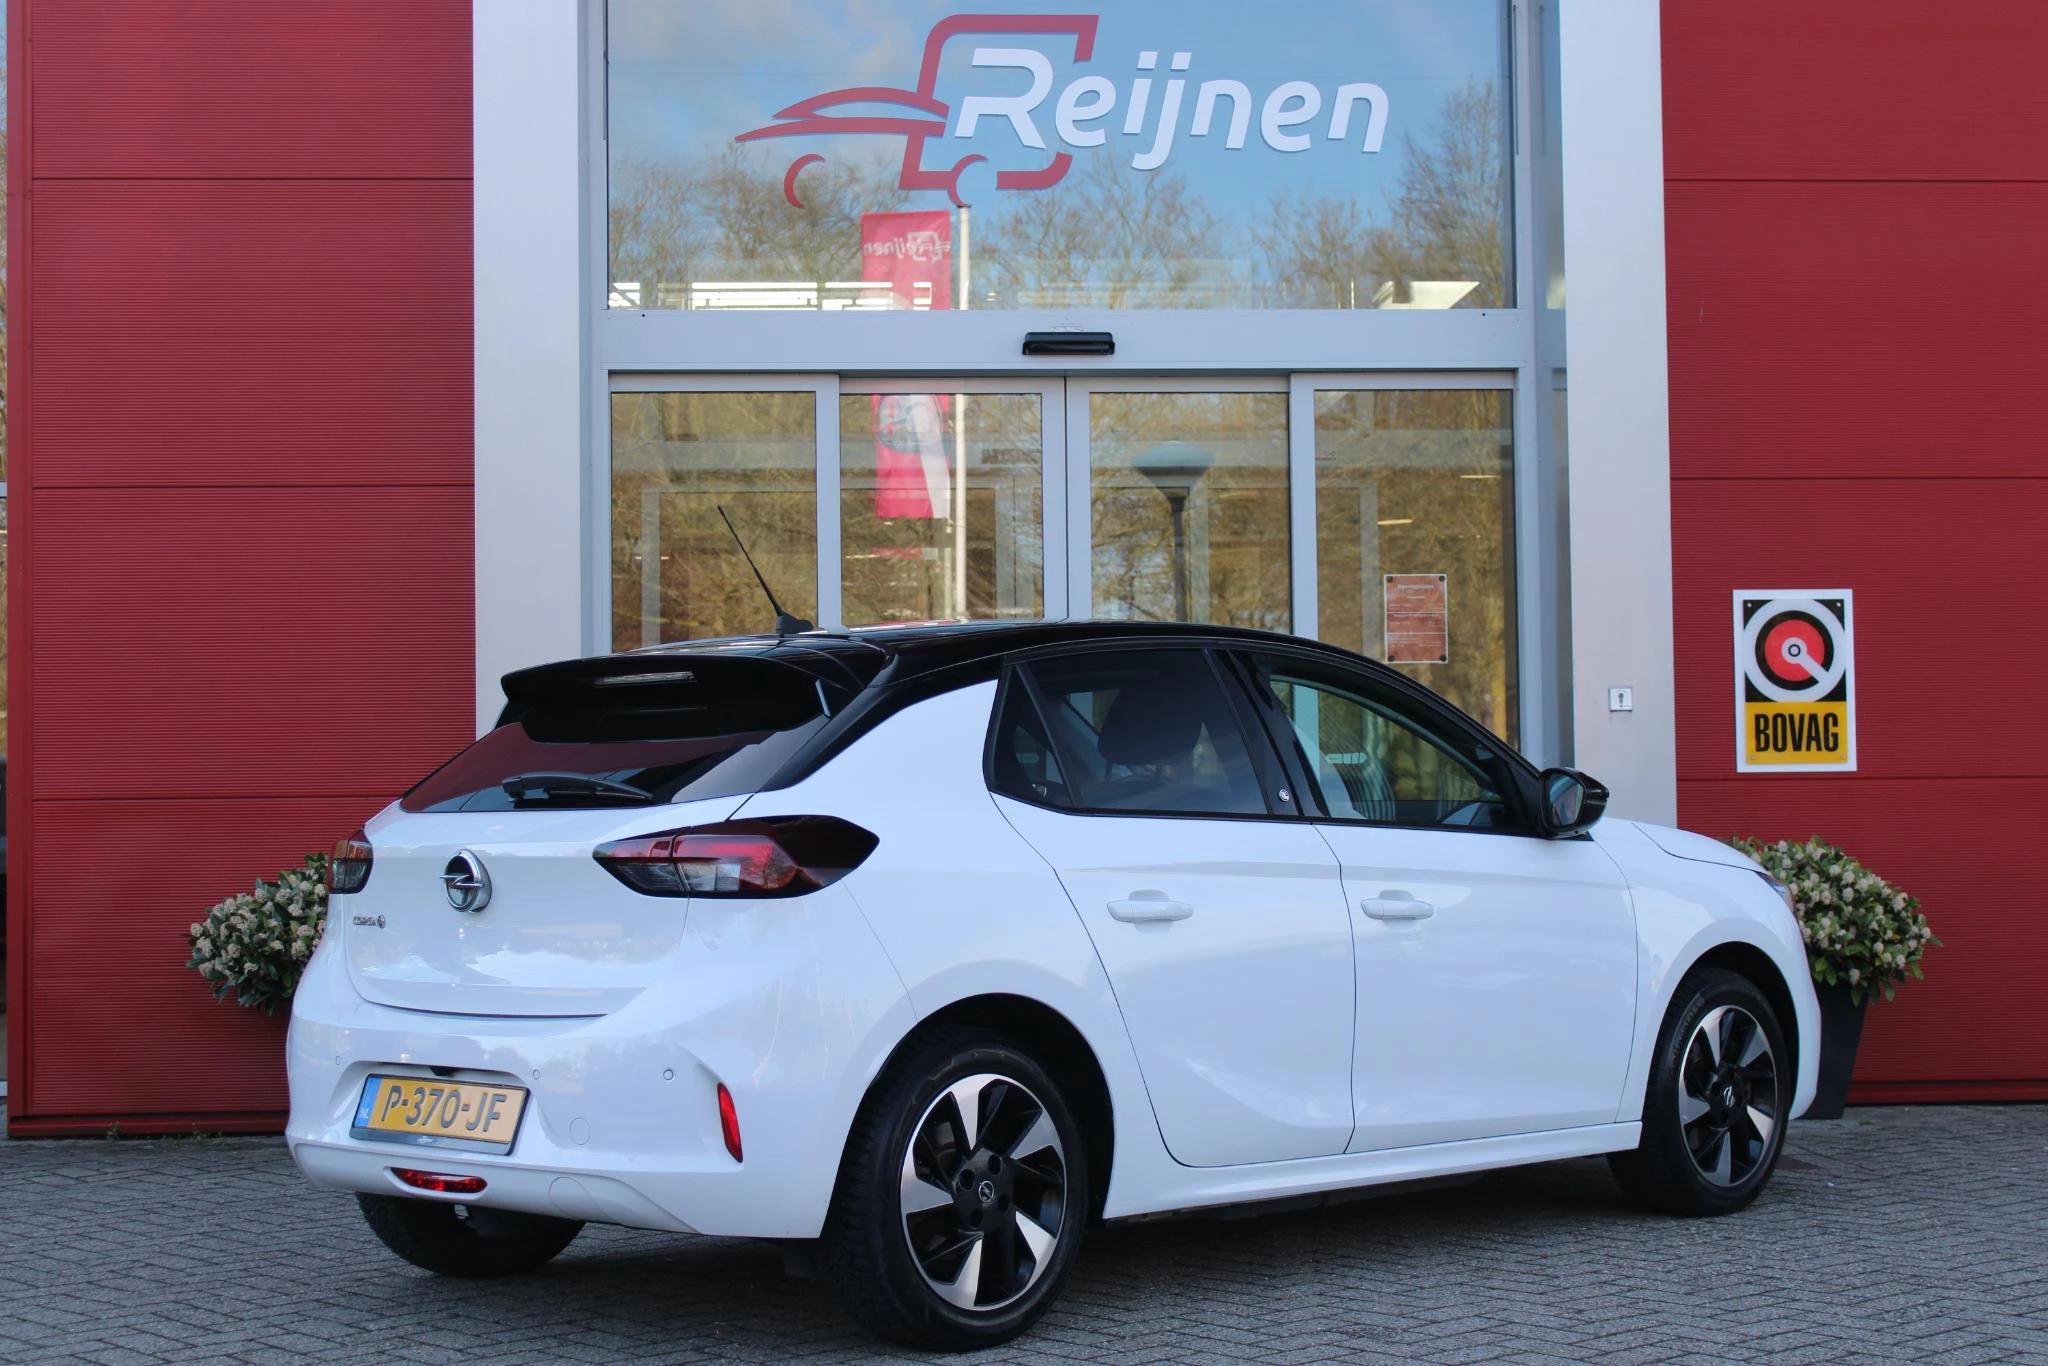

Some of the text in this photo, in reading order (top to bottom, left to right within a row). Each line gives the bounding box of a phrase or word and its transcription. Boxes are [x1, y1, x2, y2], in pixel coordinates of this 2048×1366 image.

[954, 47, 1389, 170] Reijnen
[1754, 712, 1839, 752] BOVAG
[381, 1085, 507, 1133] P-370-JF
